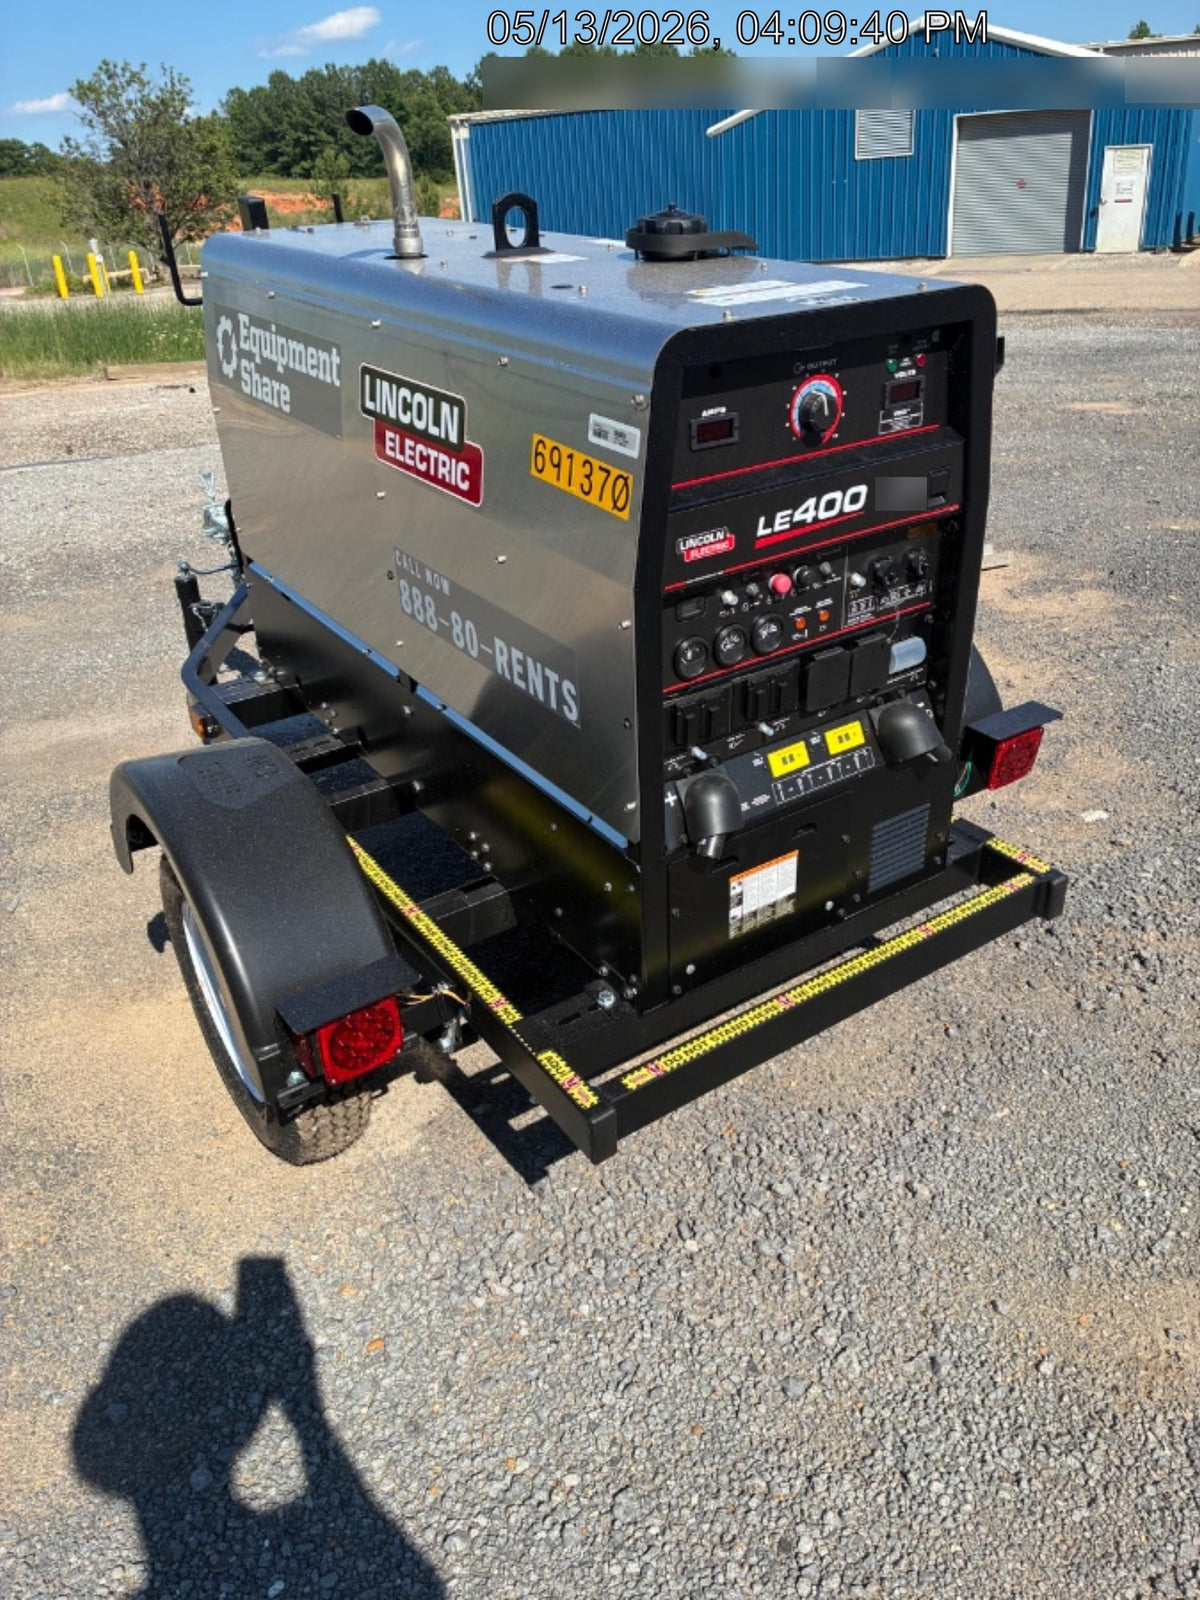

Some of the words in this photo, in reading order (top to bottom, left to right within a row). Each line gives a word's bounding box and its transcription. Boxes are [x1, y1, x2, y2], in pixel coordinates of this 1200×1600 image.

[237, 312, 341, 387] Equipment
[240, 358, 291, 413] Share
[364, 374, 459, 444] LINCOLN
[385, 429, 470, 491] ELECTRIC
[534, 438, 630, 512] 691370
[680, 529, 726, 550] LINCOLN
[757, 484, 868, 537] LE400
[395, 550, 421, 578] CALL
[425, 568, 450, 596] NOW
[399, 578, 579, 721] 888-80-RENTS
[662, 1052, 683, 1068] DO
[683, 1039, 709, 1057] NOT
[709, 1018, 748, 1043] STAND
